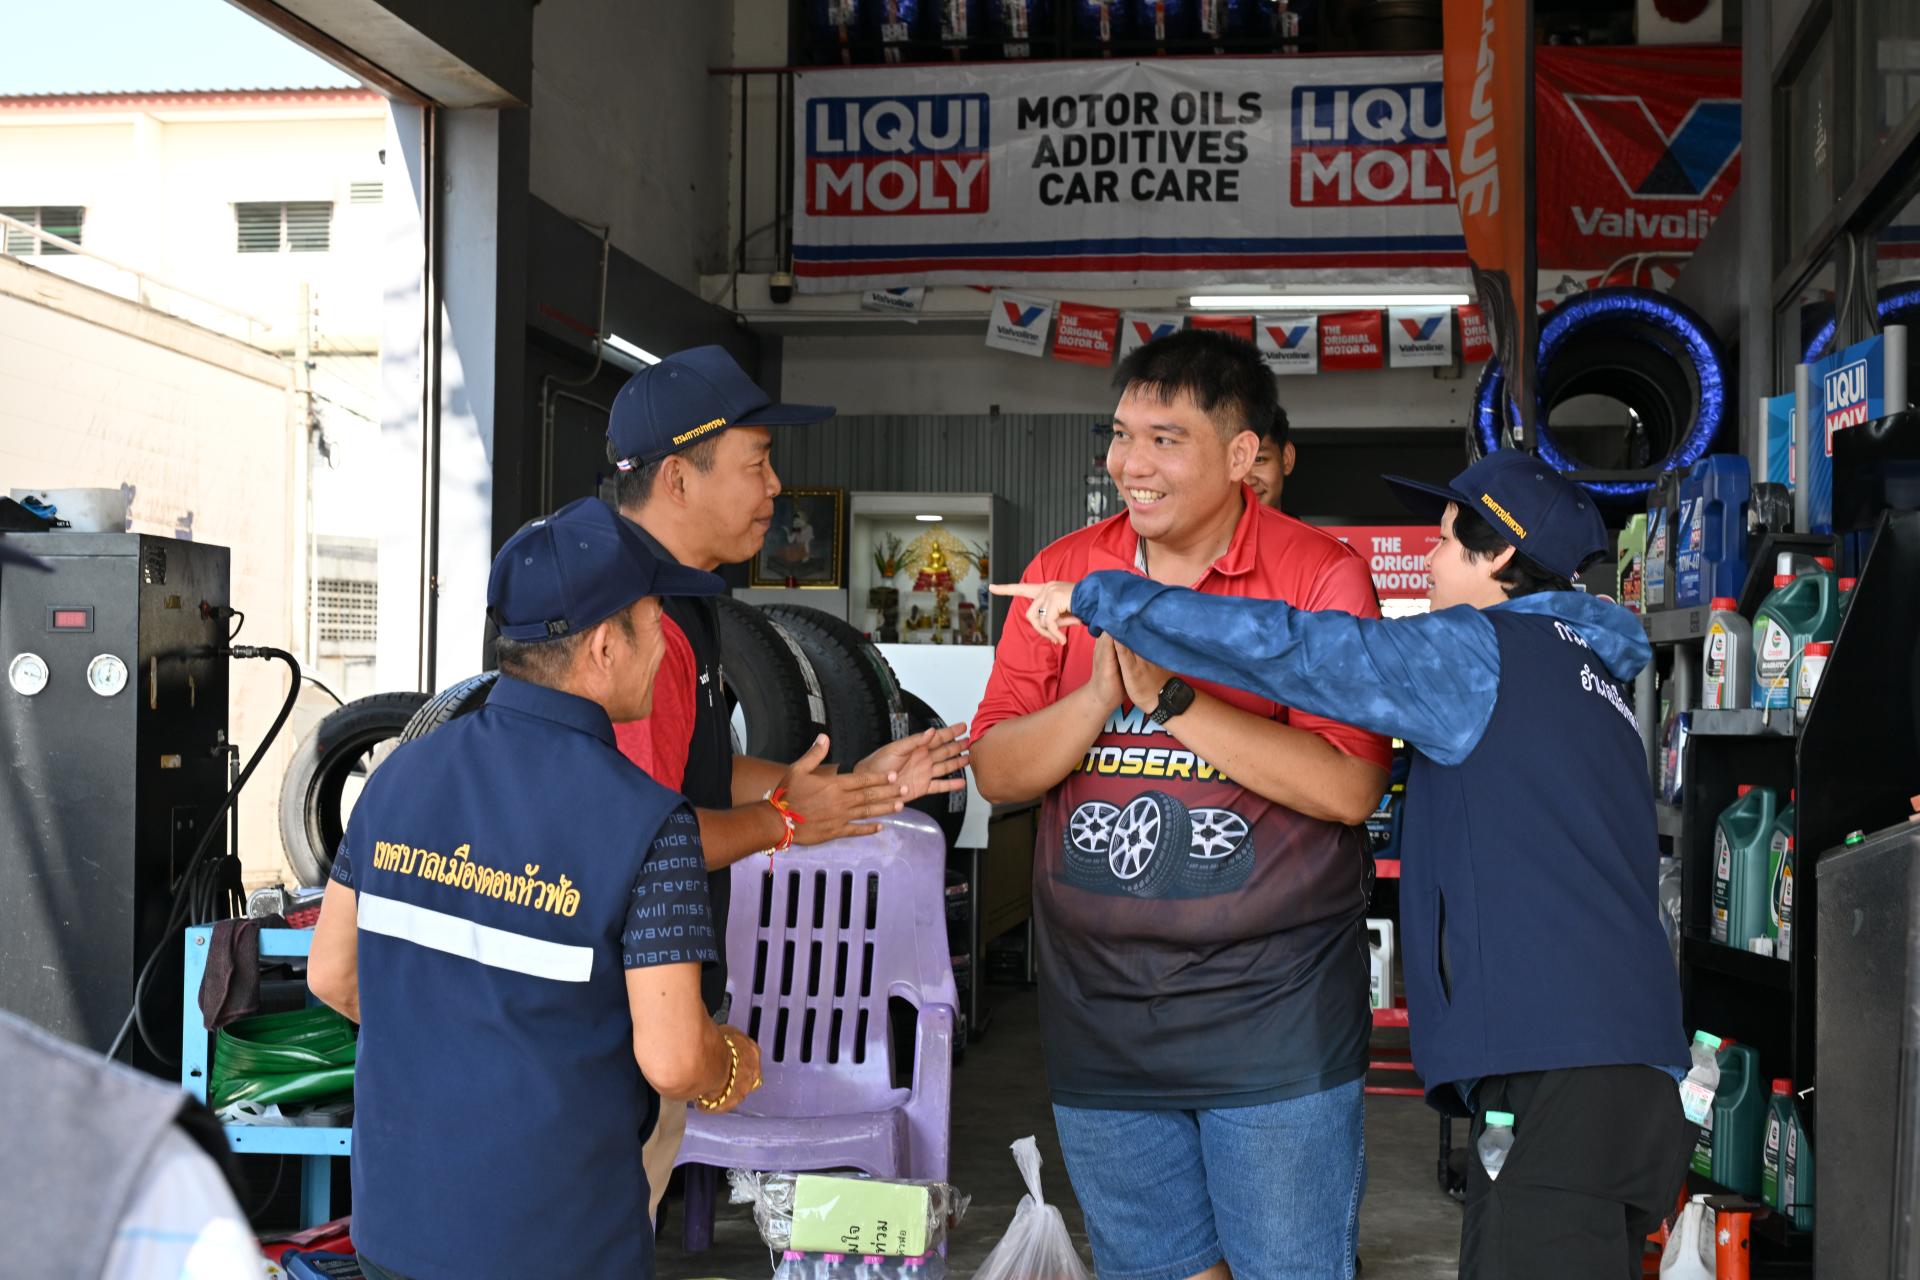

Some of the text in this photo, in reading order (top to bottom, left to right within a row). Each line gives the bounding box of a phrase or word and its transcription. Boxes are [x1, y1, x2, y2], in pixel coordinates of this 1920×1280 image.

[1018, 91, 1262, 130] MOTOR OILS
[1301, 88, 1447, 143] LIQU
[815, 100, 981, 154] LIQUI
[1031, 130, 1248, 169] ADDITIVES
[815, 159, 987, 211] MOLY
[1039, 168, 1239, 206] CAR CARE
[872, 292, 914, 308] Valvoline
[1062, 315, 1079, 326] THE
[1462, 315, 1480, 326] THE
[997, 324, 1040, 341] Valvoline
[1060, 326, 1104, 341] ORIGINAL
[1324, 325, 1341, 335] THE
[1058, 335, 1109, 350] MOTOR OIL
[1324, 334, 1370, 345] ORIGINAL
[1266, 351, 1310, 360] Valvoline
[1324, 343, 1378, 356] MOTOR OIL
[1399, 343, 1444, 353] Valvoline
[1826, 365, 1865, 412] LIQUI
[1371, 537, 1402, 552] THE
[1073, 746, 1229, 782] TOSERV
[640, 857, 697, 874] meone
[373, 840, 581, 918] เทศบาลเมืองดอนหัวฬ่อ
[637, 903, 704, 919] will miss
[631, 925, 684, 940] wawo
[636, 949, 680, 964] nara
